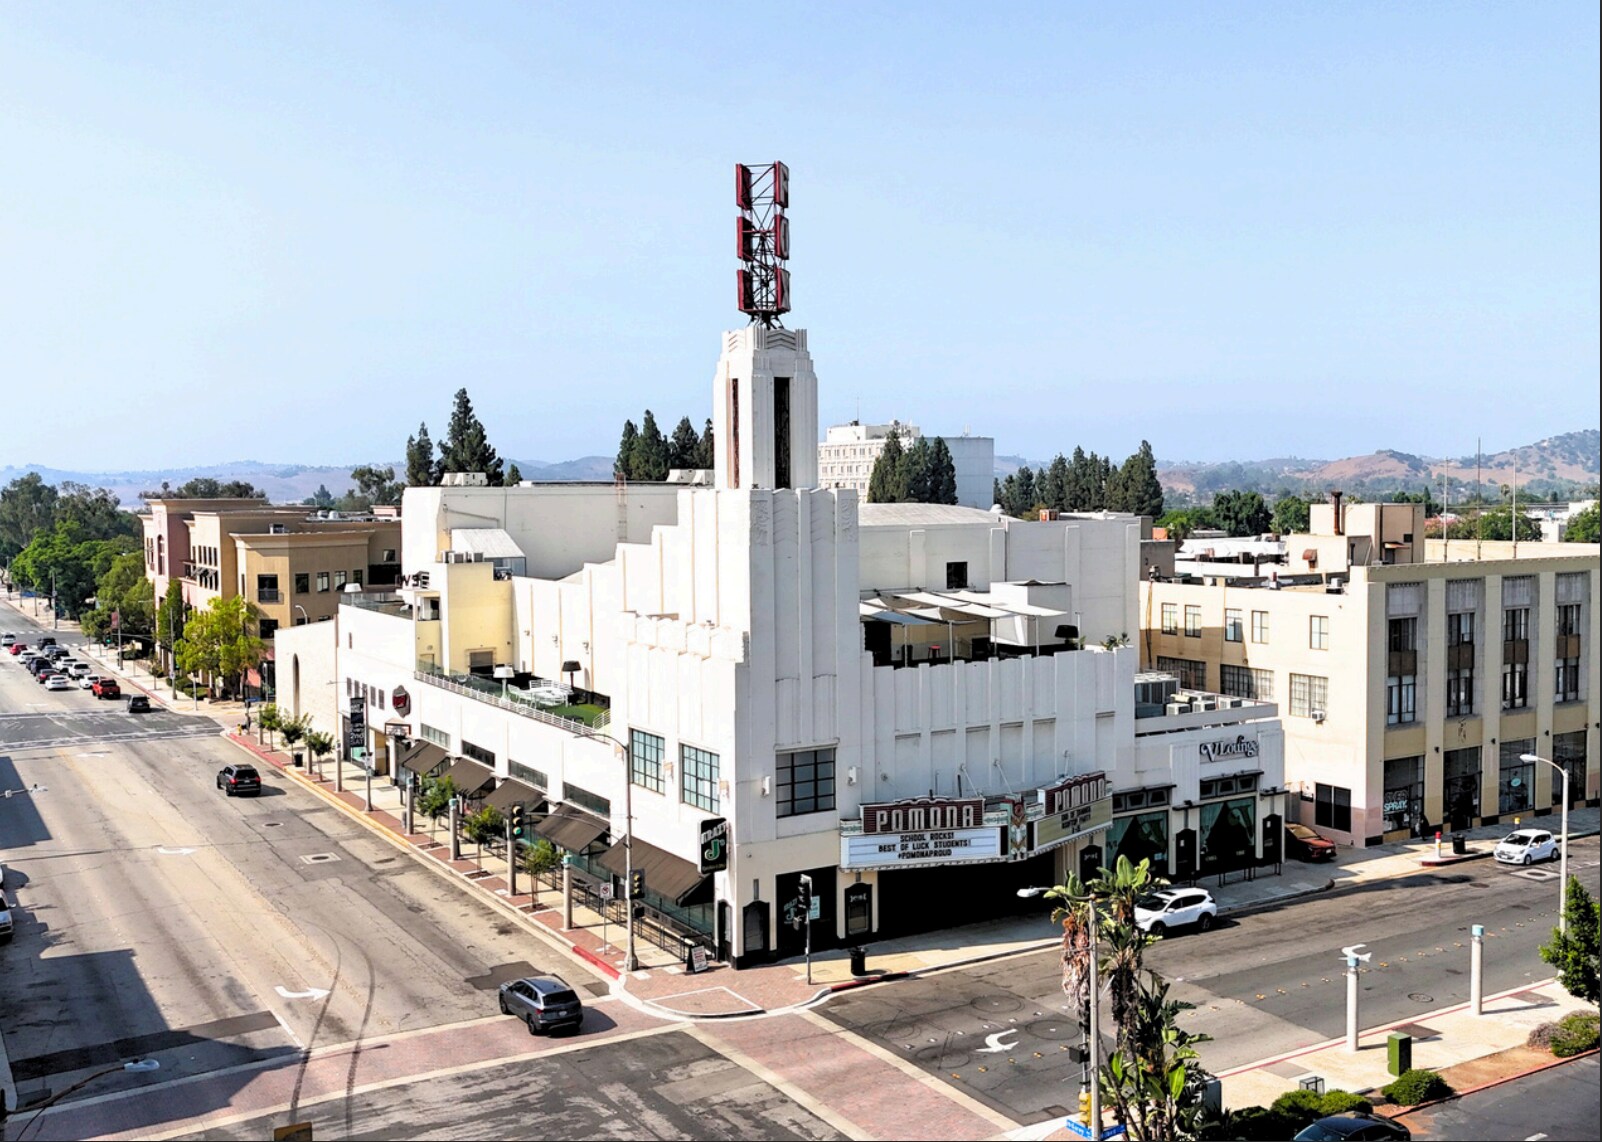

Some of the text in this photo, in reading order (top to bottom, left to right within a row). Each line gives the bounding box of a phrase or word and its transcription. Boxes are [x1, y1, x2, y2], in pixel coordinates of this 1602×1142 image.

[1055, 778, 1105, 814] POMONA
[875, 805, 974, 831] POMONA
[900, 832, 954, 842] SCHOOL ROCKS!
[878, 839, 971, 852] BEST OF LUCK STUDENTS!
[898, 849, 952, 859] #POMONAPROUD
